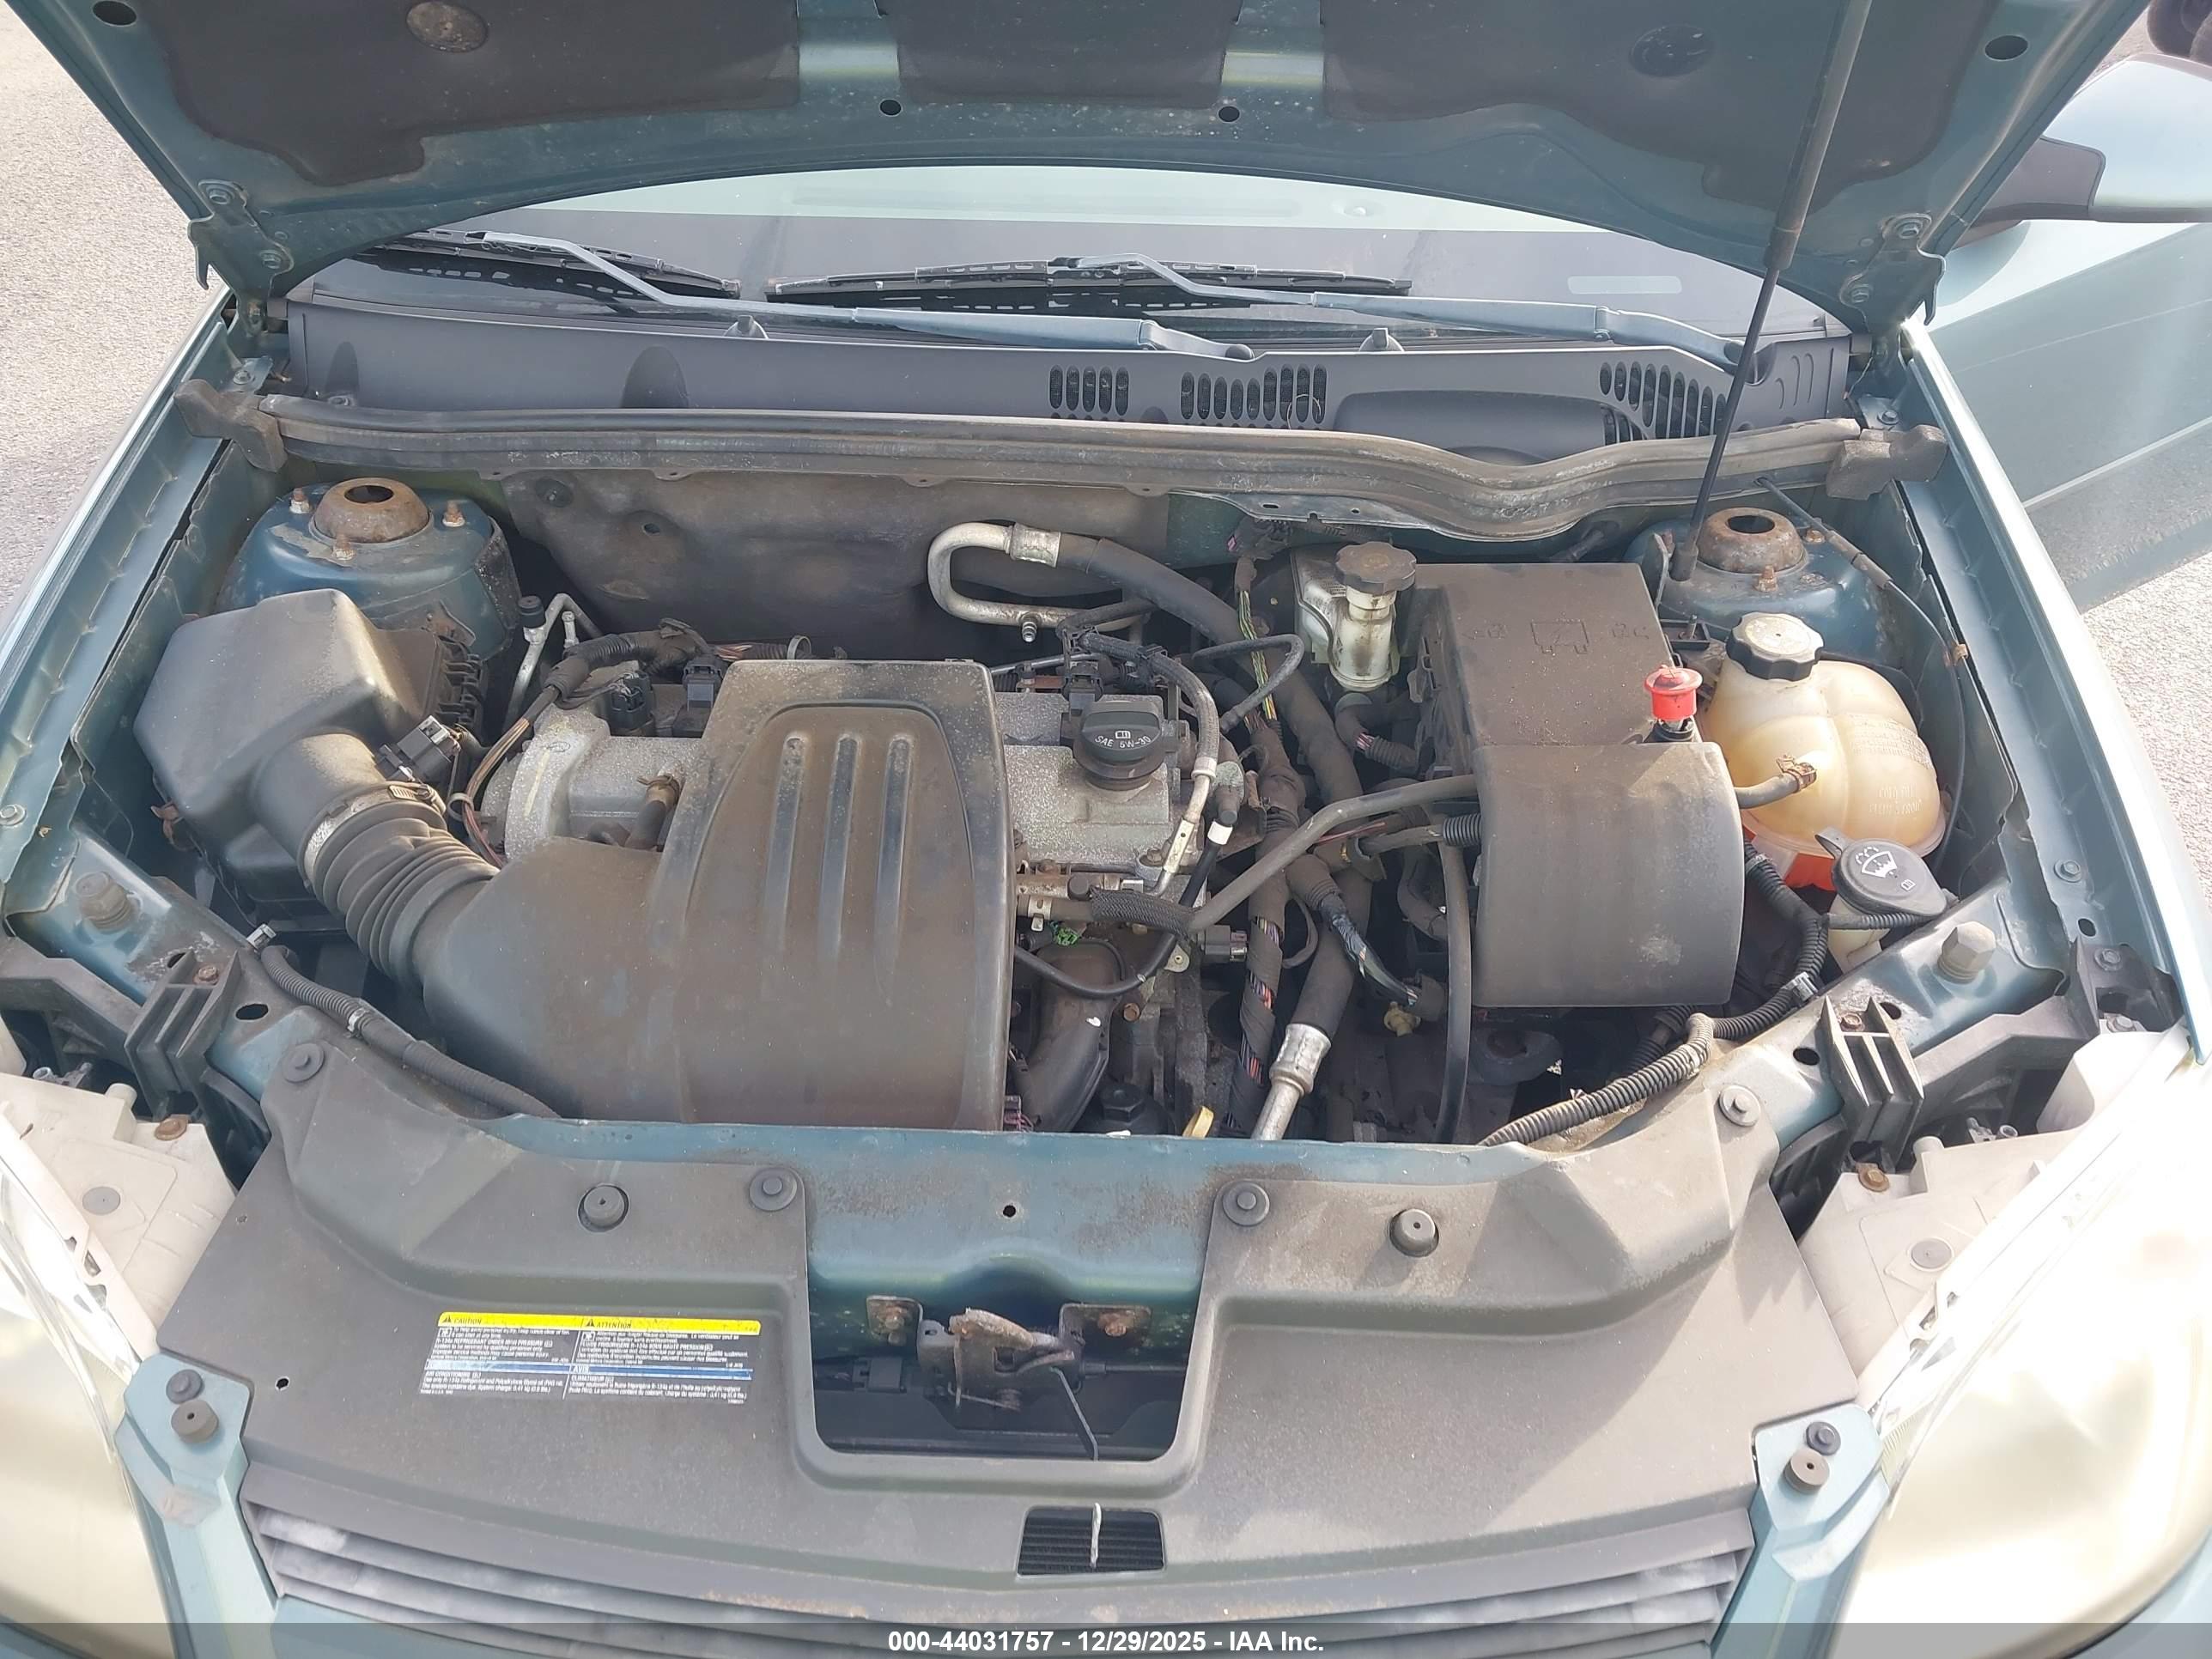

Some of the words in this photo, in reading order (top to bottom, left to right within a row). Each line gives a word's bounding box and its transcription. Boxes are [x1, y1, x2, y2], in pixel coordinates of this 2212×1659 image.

[1094, 735, 1115, 747] SAE
[1119, 735, 1152, 749] 5W-30
[596, 1321, 631, 1329] ATTENTION
